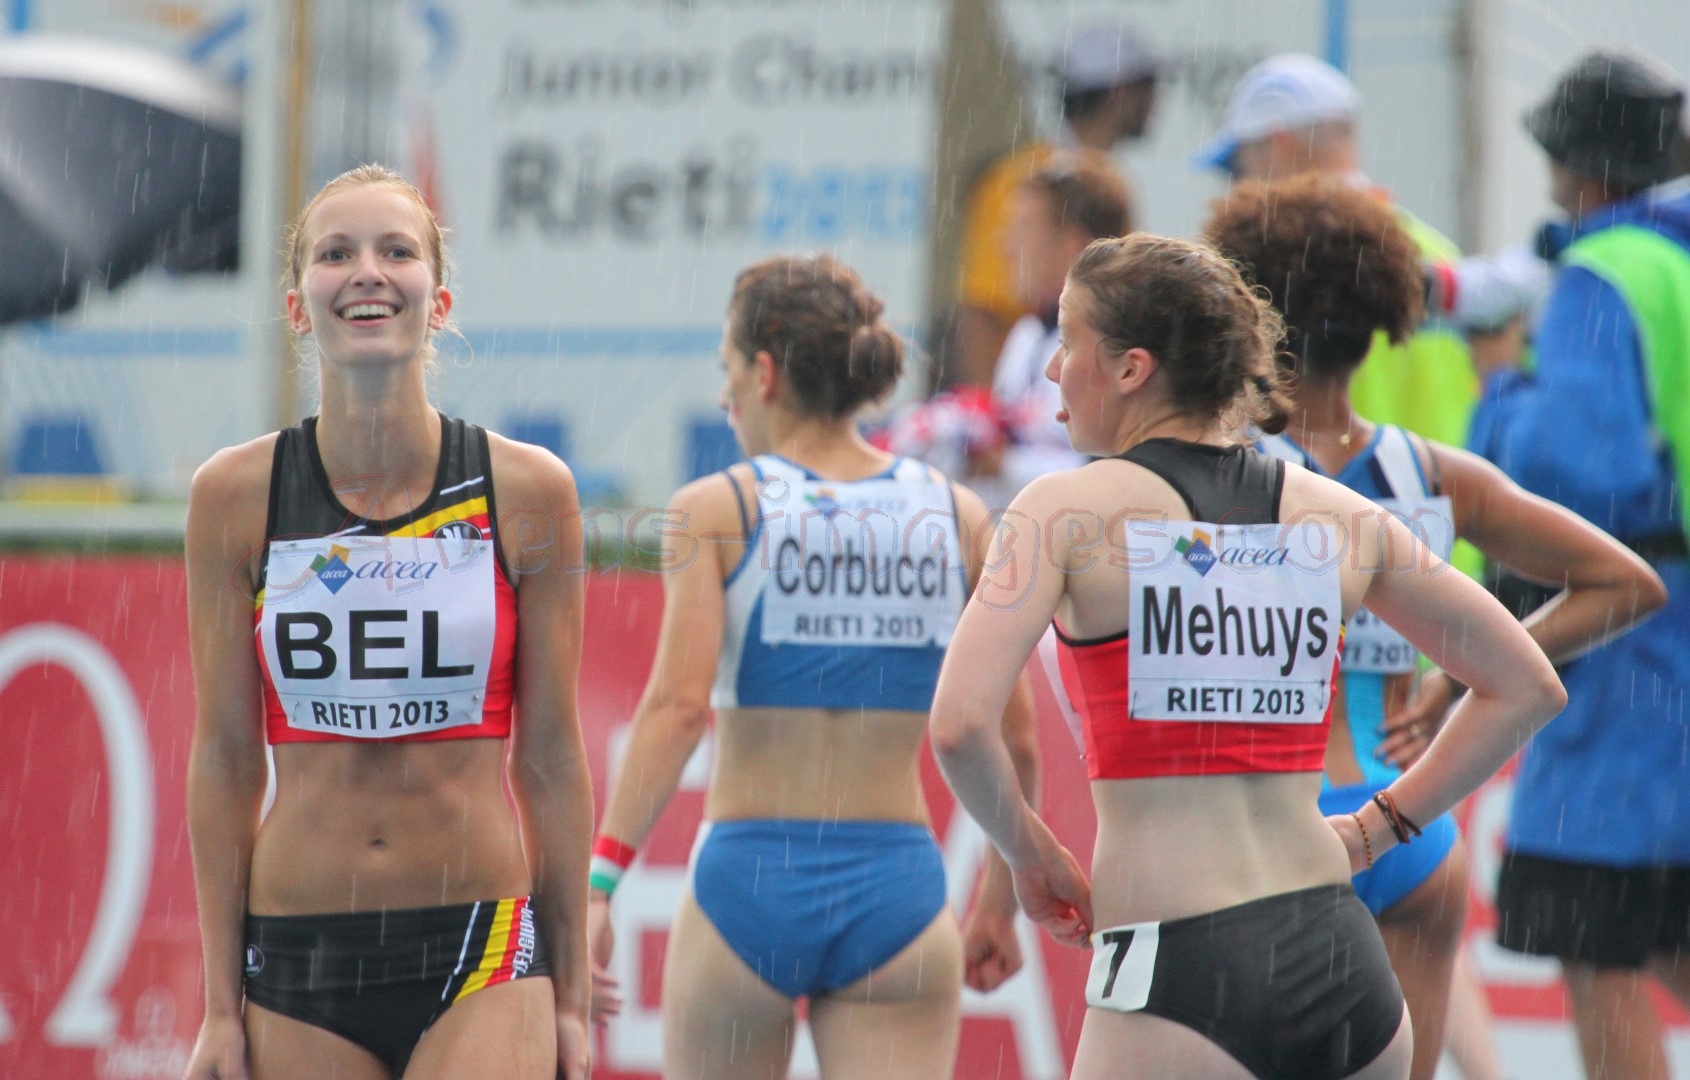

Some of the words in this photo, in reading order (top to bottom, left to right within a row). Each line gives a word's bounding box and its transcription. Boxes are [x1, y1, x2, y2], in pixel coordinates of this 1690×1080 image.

[355, 558, 439, 580] acea
[776, 536, 949, 597] Corbucci
[1219, 546, 1289, 566] acea
[794, 614, 863, 635] RIETI
[874, 614, 924, 637] 2013
[1142, 585, 1328, 677] Mehuys
[275, 610, 475, 681] BEL
[311, 701, 377, 730] RIETI
[389, 700, 449, 729] 2013
[1167, 687, 1242, 713] RIETI
[1252, 688, 1305, 714] 2013
[1101, 929, 1136, 999] 7
